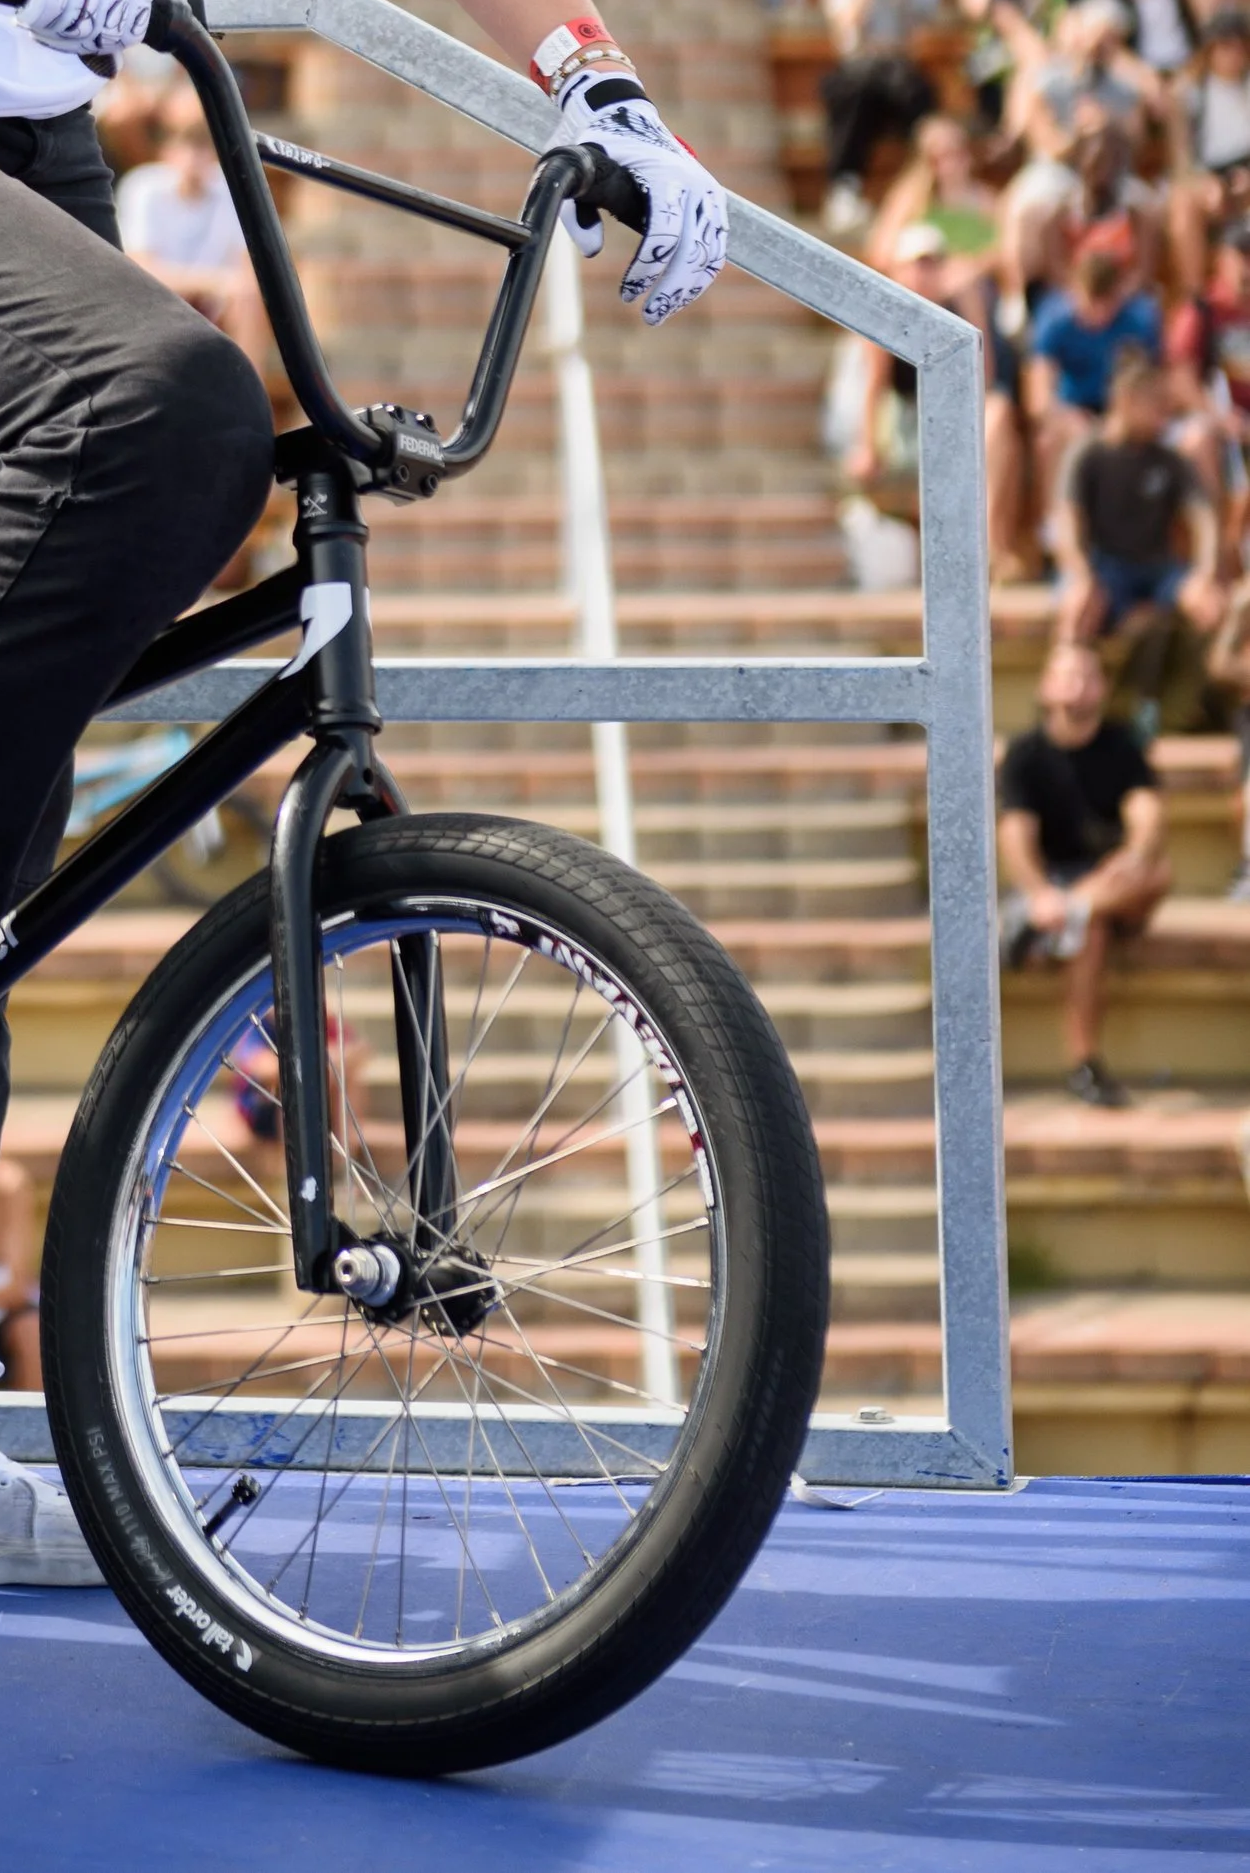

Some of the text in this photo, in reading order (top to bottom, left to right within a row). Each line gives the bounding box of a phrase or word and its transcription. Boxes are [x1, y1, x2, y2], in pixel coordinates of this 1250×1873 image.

[400, 433, 443, 461] FEDERAL
[86, 1427, 106, 1459] PSI
[97, 1462, 125, 1503] MAX
[165, 1584, 235, 1655] tall order
